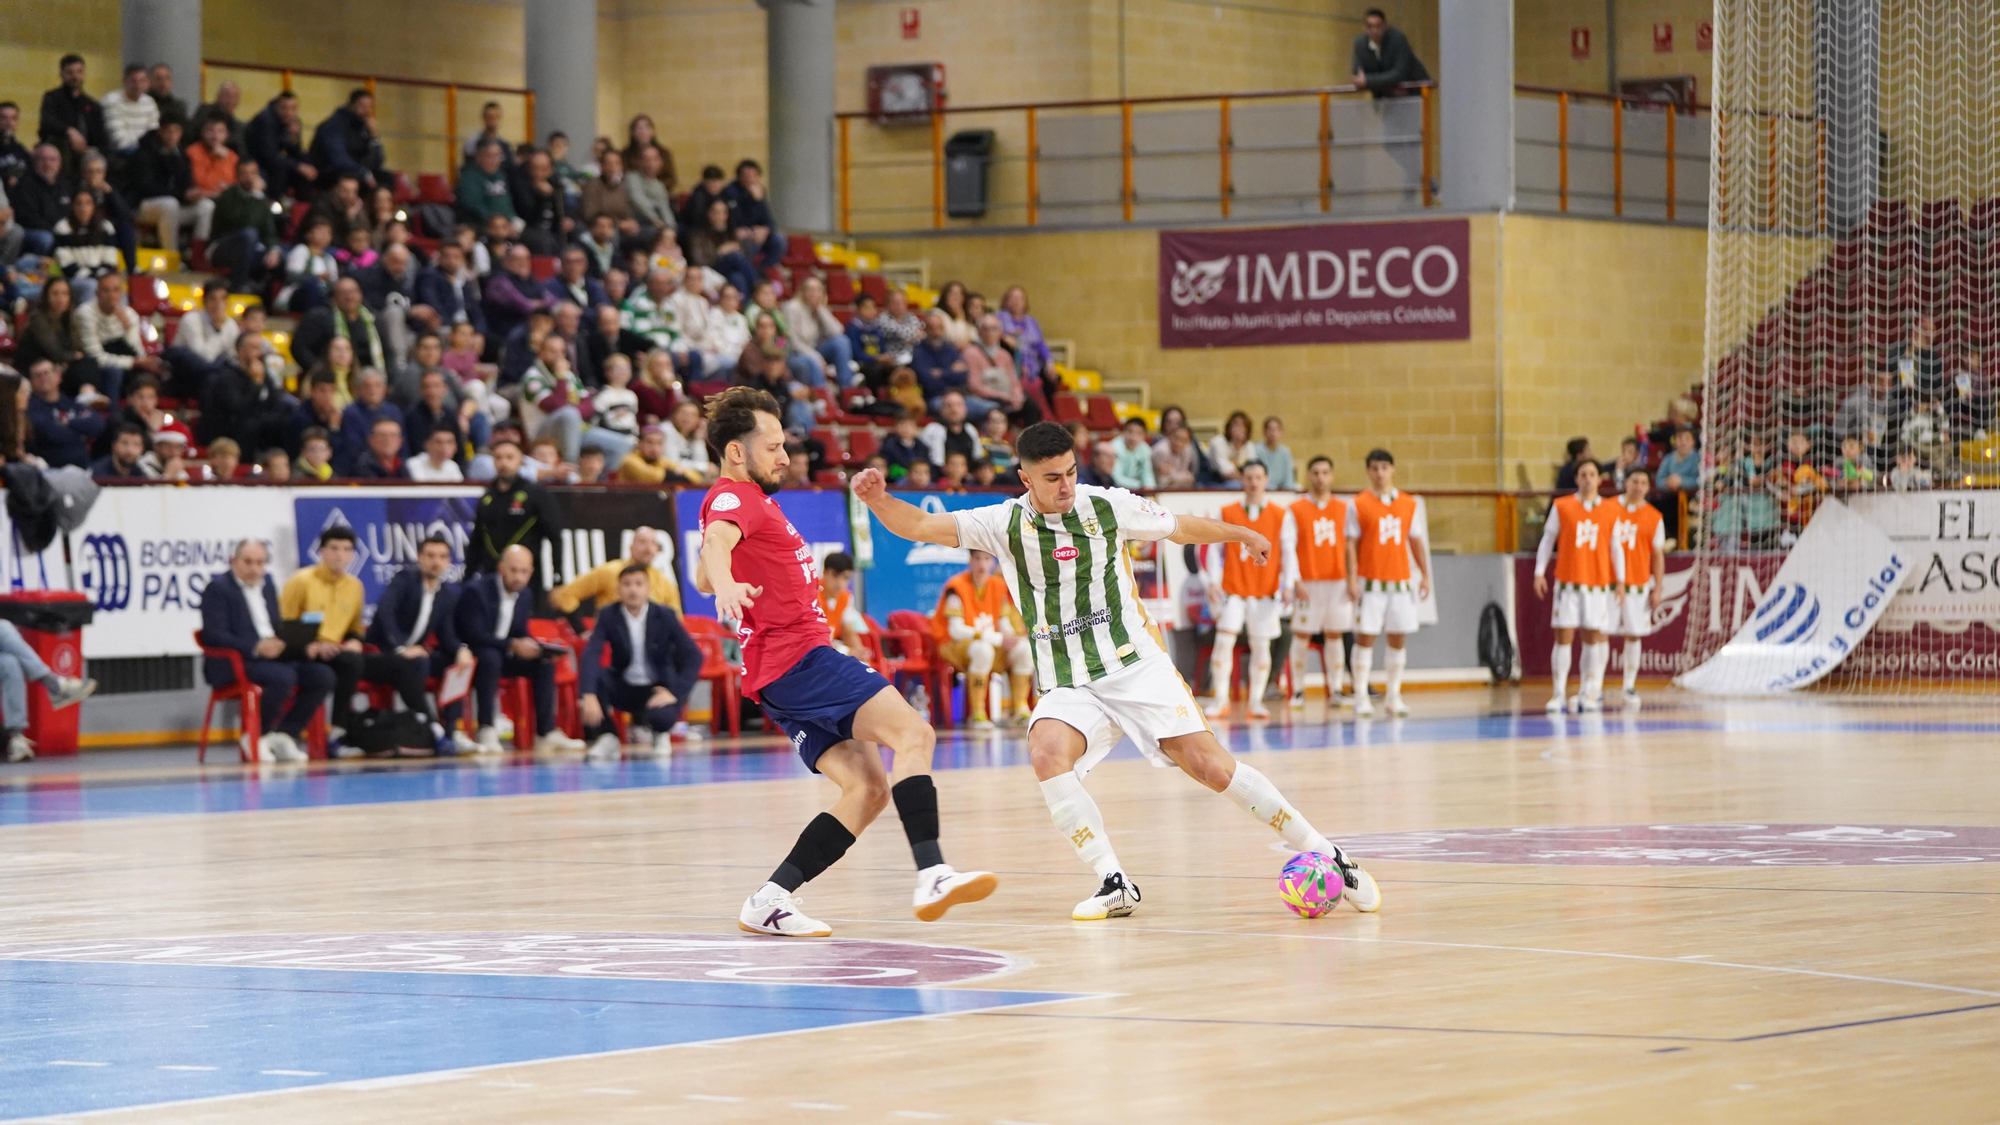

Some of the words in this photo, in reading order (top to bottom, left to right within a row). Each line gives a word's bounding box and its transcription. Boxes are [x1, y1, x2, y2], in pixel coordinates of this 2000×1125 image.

[1236, 244, 1459, 303] IMDECO
[1171, 313, 1231, 332] Instituto
[1325, 306, 1391, 329] Deportes
[1936, 499, 1990, 541] EL
